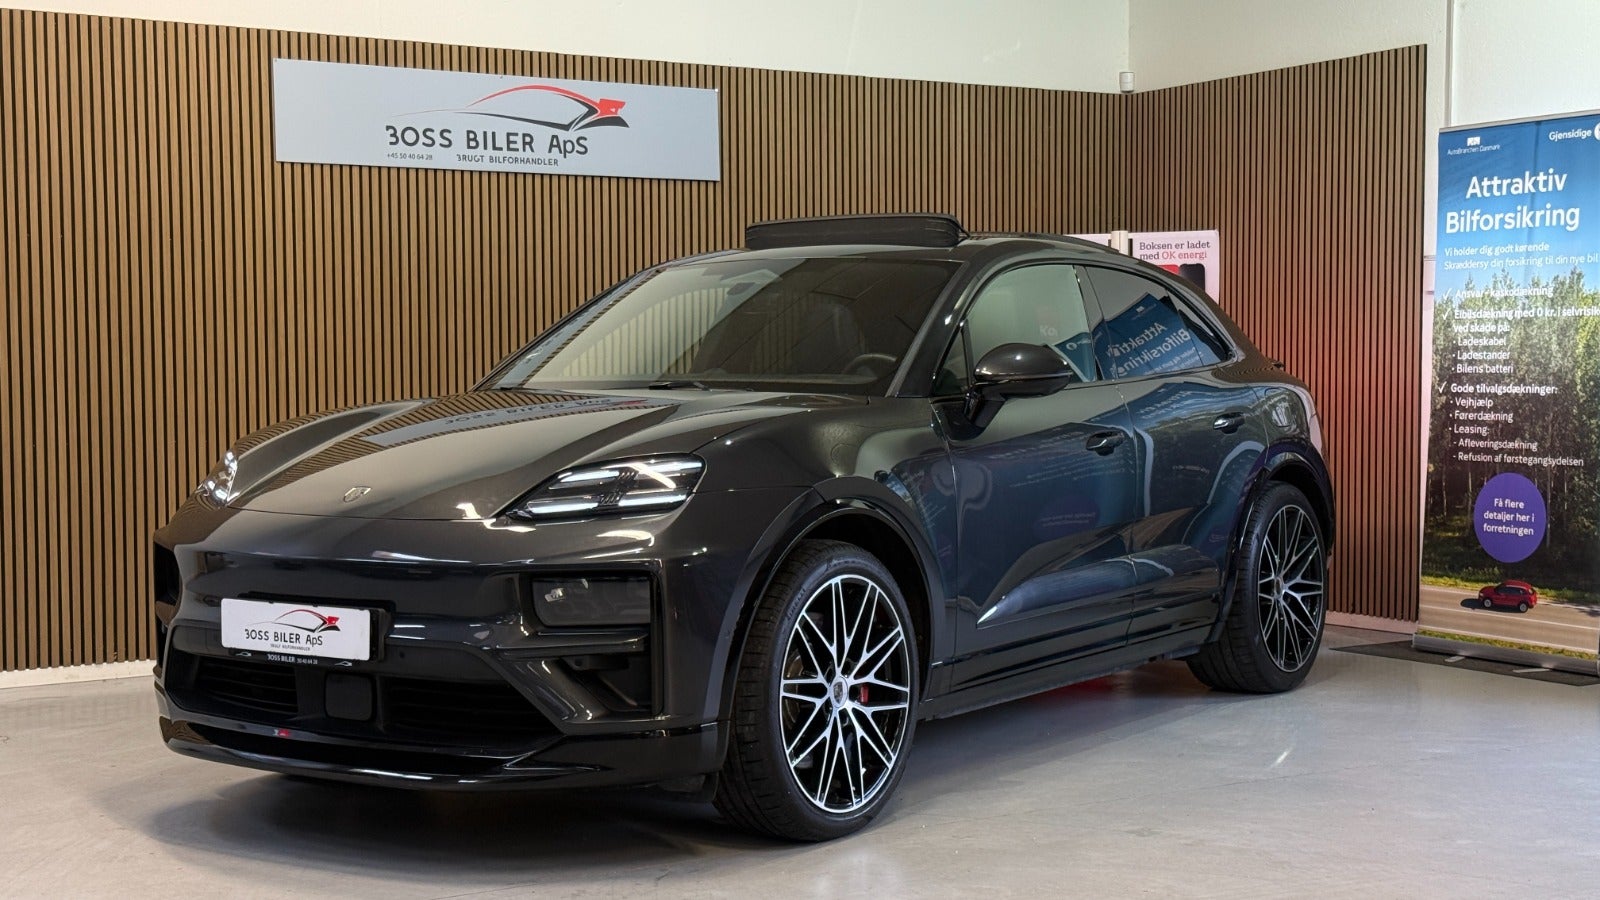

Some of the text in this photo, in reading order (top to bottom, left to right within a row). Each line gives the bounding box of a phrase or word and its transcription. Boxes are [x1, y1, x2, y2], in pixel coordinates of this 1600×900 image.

[1549, 130, 1592, 141] Gjensidige
[466, 130, 535, 153] BILER
[548, 134, 588, 159] ApS
[489, 155, 559, 167] BILFORHANDLER
[1465, 168, 1568, 199] Attraktiv
[1445, 203, 1580, 234] Bilforsikring
[1139, 242, 1173, 251] Boksen
[1187, 240, 1211, 249] ladet
[1444, 242, 1550, 257] Vi holder dig godt kørende
[1140, 250, 1208, 260] med OK energi
[1444, 253, 1599, 270] Skræddersy din forsikring til din nye bil
[1515, 308, 1534, 318] med
[1537, 308, 1543, 317] 0
[1545, 308, 1556, 316] kr.
[1562, 304, 1600, 317] selvrisik
[1453, 324, 1468, 332] ved
[1470, 322, 1496, 332] skade
[1458, 337, 1506, 346] Ladeskabel
[1457, 350, 1510, 360] Ladestander
[1456, 364, 1514, 374] Bilens batteri
[1450, 383, 1558, 396] Gode tilvalgsdækninger:
[1454, 397, 1494, 408] Vejhjælp
[1454, 410, 1514, 424] Førerdækning
[1454, 424, 1490, 436] Leasing:
[1458, 438, 1538, 452] Afleveringsdækning
[1458, 452, 1584, 466] Refusion af førstegangsydelsen
[1494, 498, 1524, 508] Få flere
[1483, 510, 1535, 522] detaljer her i
[1483, 522, 1534, 536] forretningen
[274, 632, 300, 644] BILER
[306, 635, 323, 648] ApS
